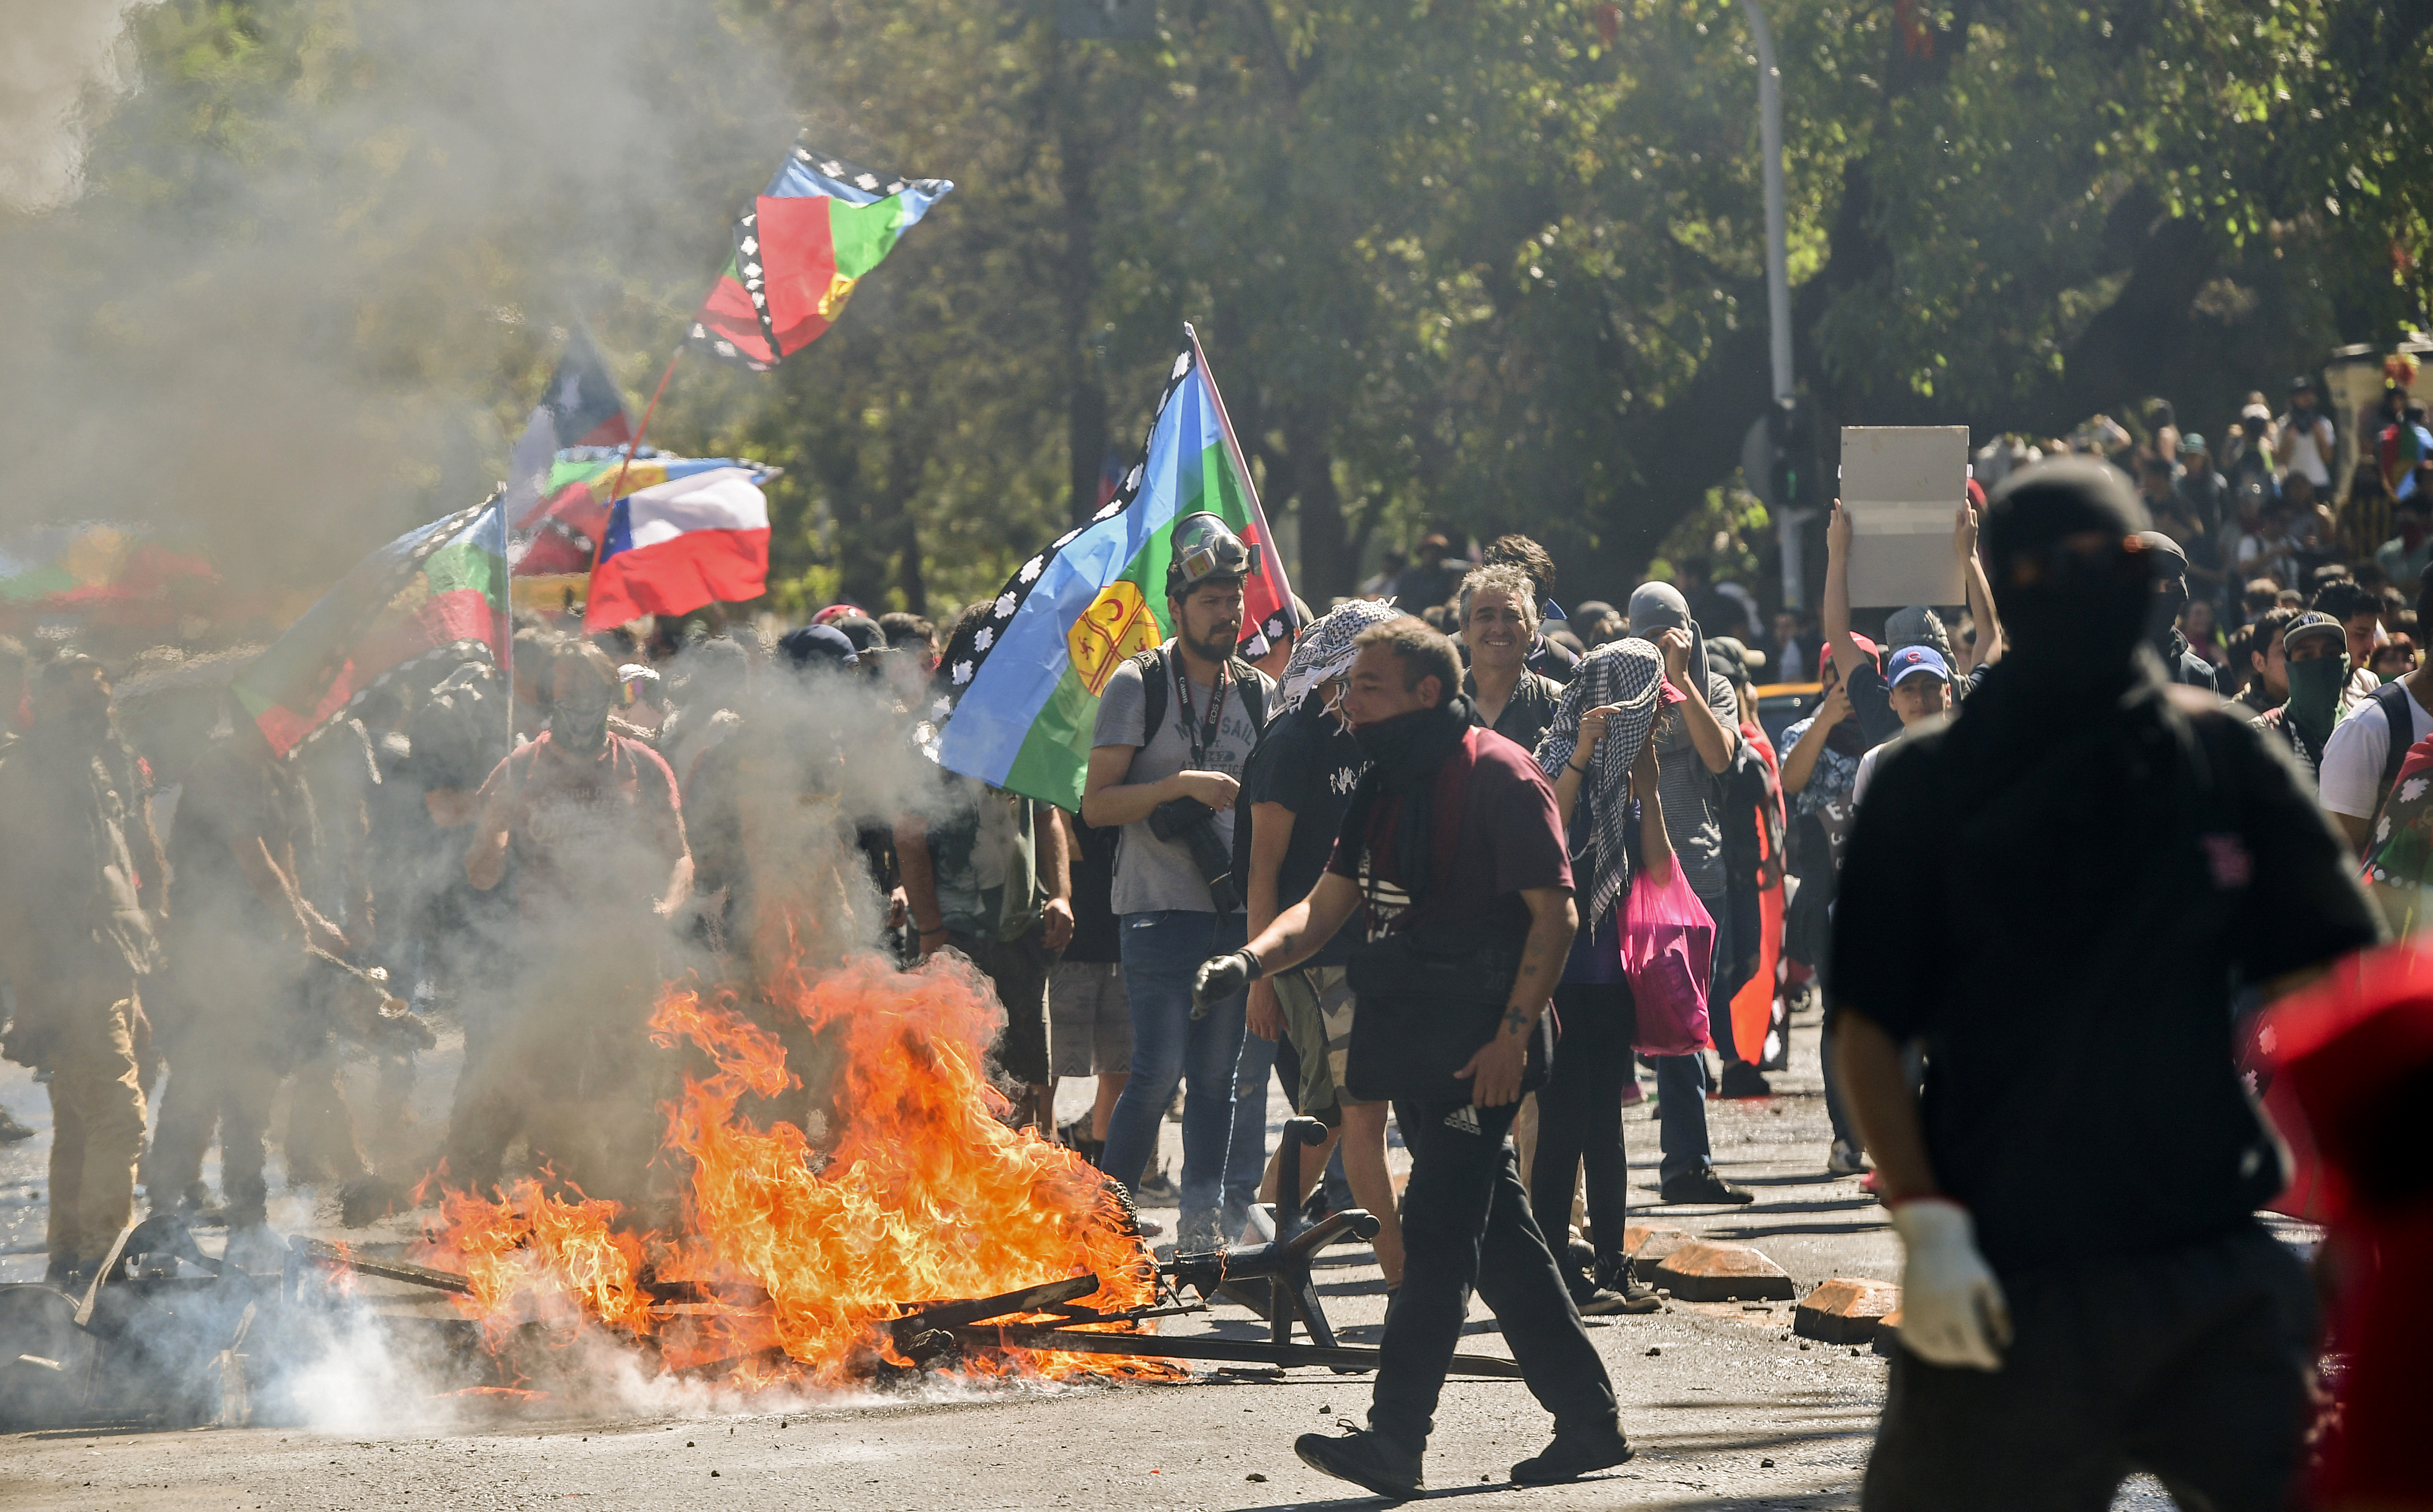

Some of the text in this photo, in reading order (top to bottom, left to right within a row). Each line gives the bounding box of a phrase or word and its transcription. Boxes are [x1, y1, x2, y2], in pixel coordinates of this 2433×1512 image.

[1179, 677, 1188, 704] Canon
[1209, 704, 1219, 724] EOS
[1214, 691, 1222, 702] 7D
[1221, 716, 1253, 745] SAIL
[1444, 1117, 1481, 1135] adidas
